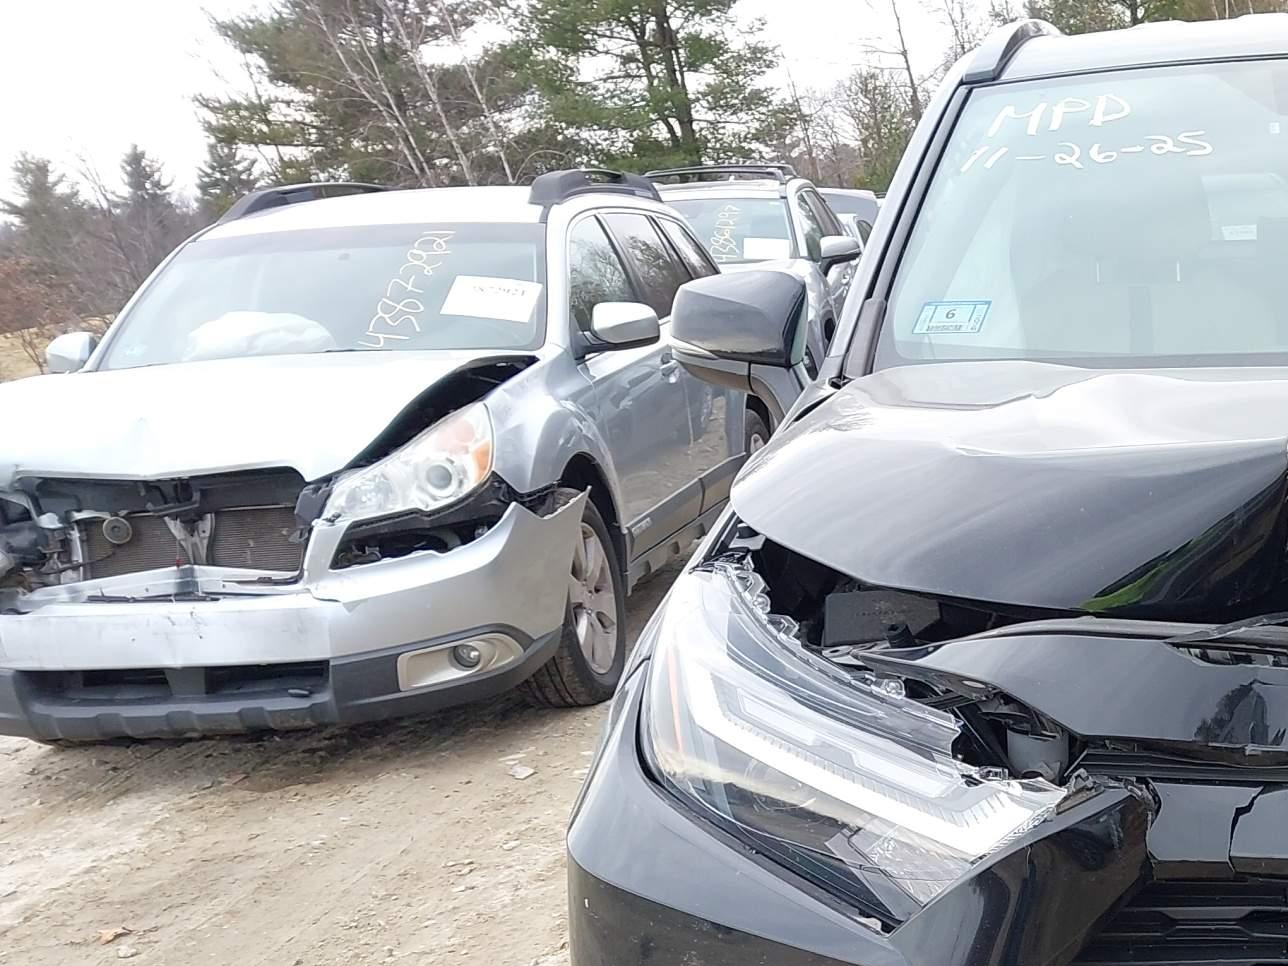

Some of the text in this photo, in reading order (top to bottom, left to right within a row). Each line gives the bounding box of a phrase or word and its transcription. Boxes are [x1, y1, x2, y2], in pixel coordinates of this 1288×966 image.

[986, 94, 1131, 138] MPD
[960, 130, 1214, 173] 11-26-25
[357, 230, 456, 348] 43872921
[945, 308, 957, 320] 6
